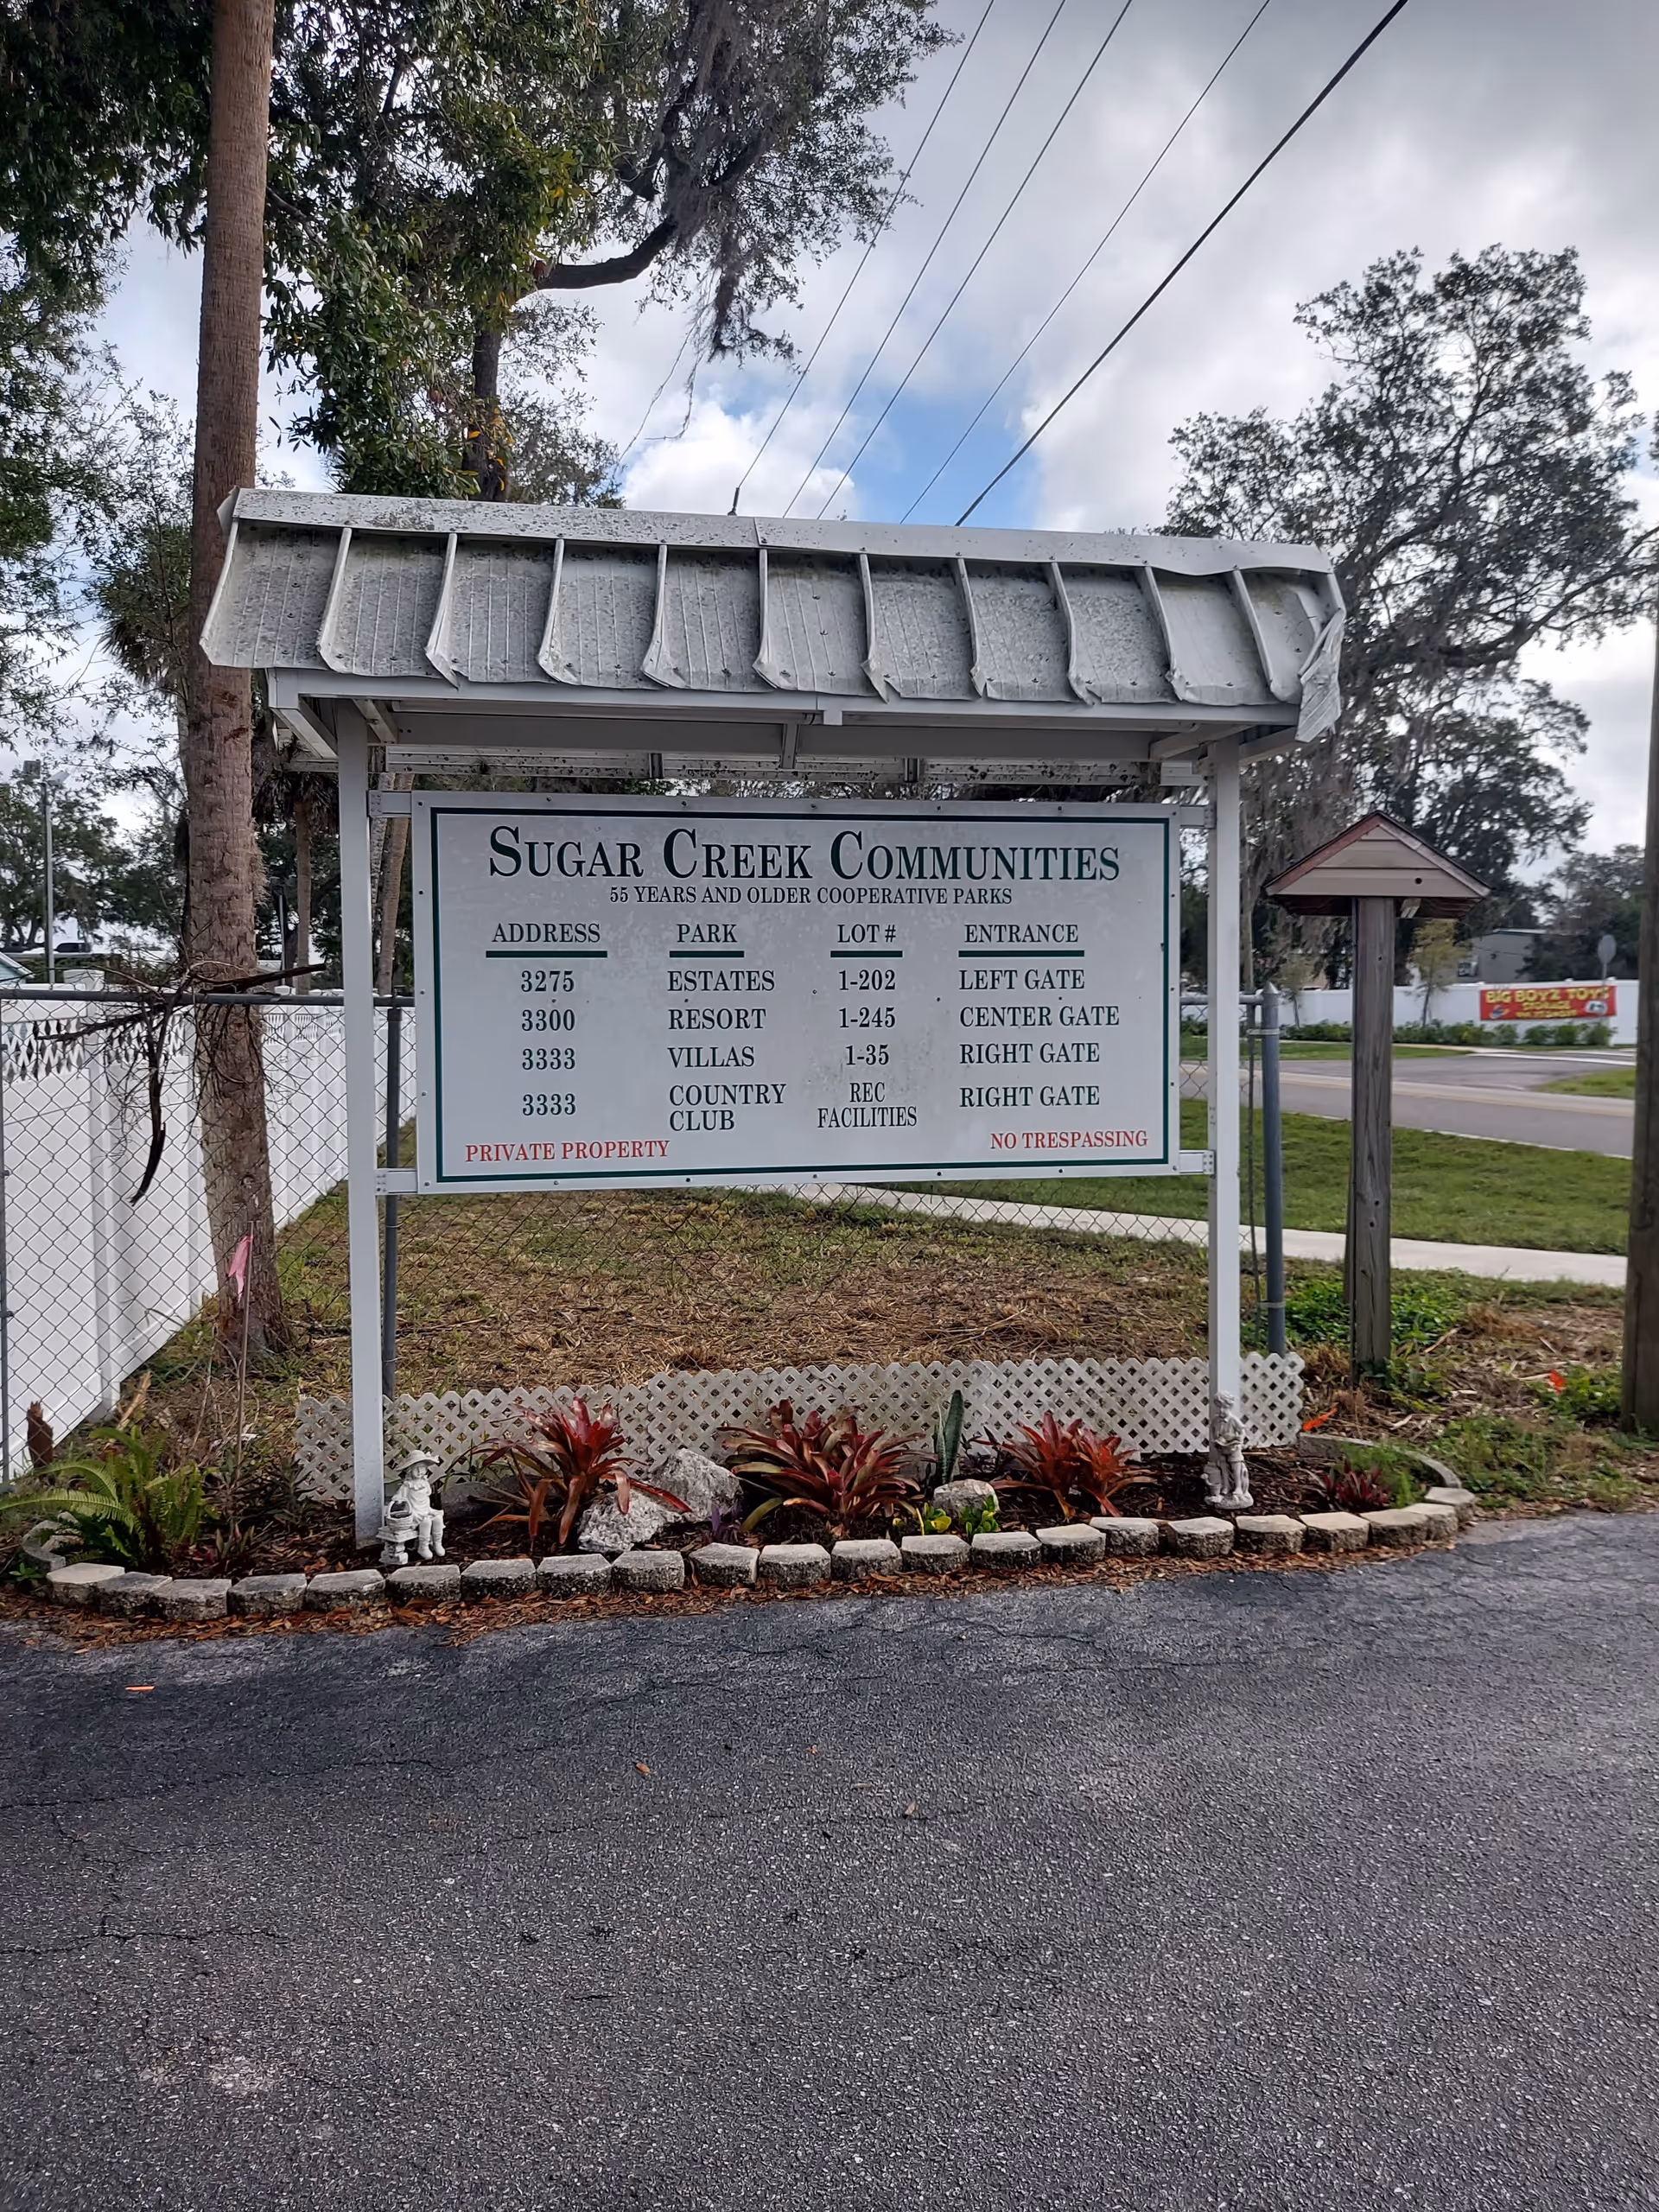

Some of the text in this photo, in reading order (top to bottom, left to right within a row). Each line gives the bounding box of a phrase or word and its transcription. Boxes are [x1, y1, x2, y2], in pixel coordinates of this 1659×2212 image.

[489, 825, 1120, 881] SUGAR CREEK COMMUNITIES
[609, 886, 1013, 905] 55 YEARS AND OLDER COOPERATIVE PARKS
[491, 923, 601, 944] ADDRESS
[676, 924, 738, 944] PARK
[964, 924, 1078, 944] ENTRANCE
[520, 969, 575, 993] 3275
[667, 969, 775, 992] ESTATES
[838, 969, 896, 991] 1-202
[958, 969, 1085, 990] LEFT GATE
[1486, 991, 1512, 1003] BIG
[1515, 990, 1560, 1002] BOYZ
[521, 1008, 575, 1032] 3300
[668, 1007, 766, 1030] RESORT
[838, 1007, 896, 1028] 1-245
[960, 1005, 1120, 1027] CENTER GATE
[522, 1047, 575, 1071] 3333
[666, 1046, 755, 1069] VILLAS
[845, 1044, 889, 1065] 1-35
[959, 1042, 1100, 1065] RIGHT GATE
[669, 1084, 787, 1107] COUNTRY
[849, 1081, 886, 1103] REC
[959, 1085, 1100, 1108] RIGHT GATE
[522, 1093, 576, 1116] 3333
[669, 1109, 735, 1132] CLUB
[817, 1105, 918, 1128] FACILITIES
[990, 1129, 1148, 1150] NO TRESPASSING
[465, 1140, 671, 1162] PRIVATE PROPERTY
